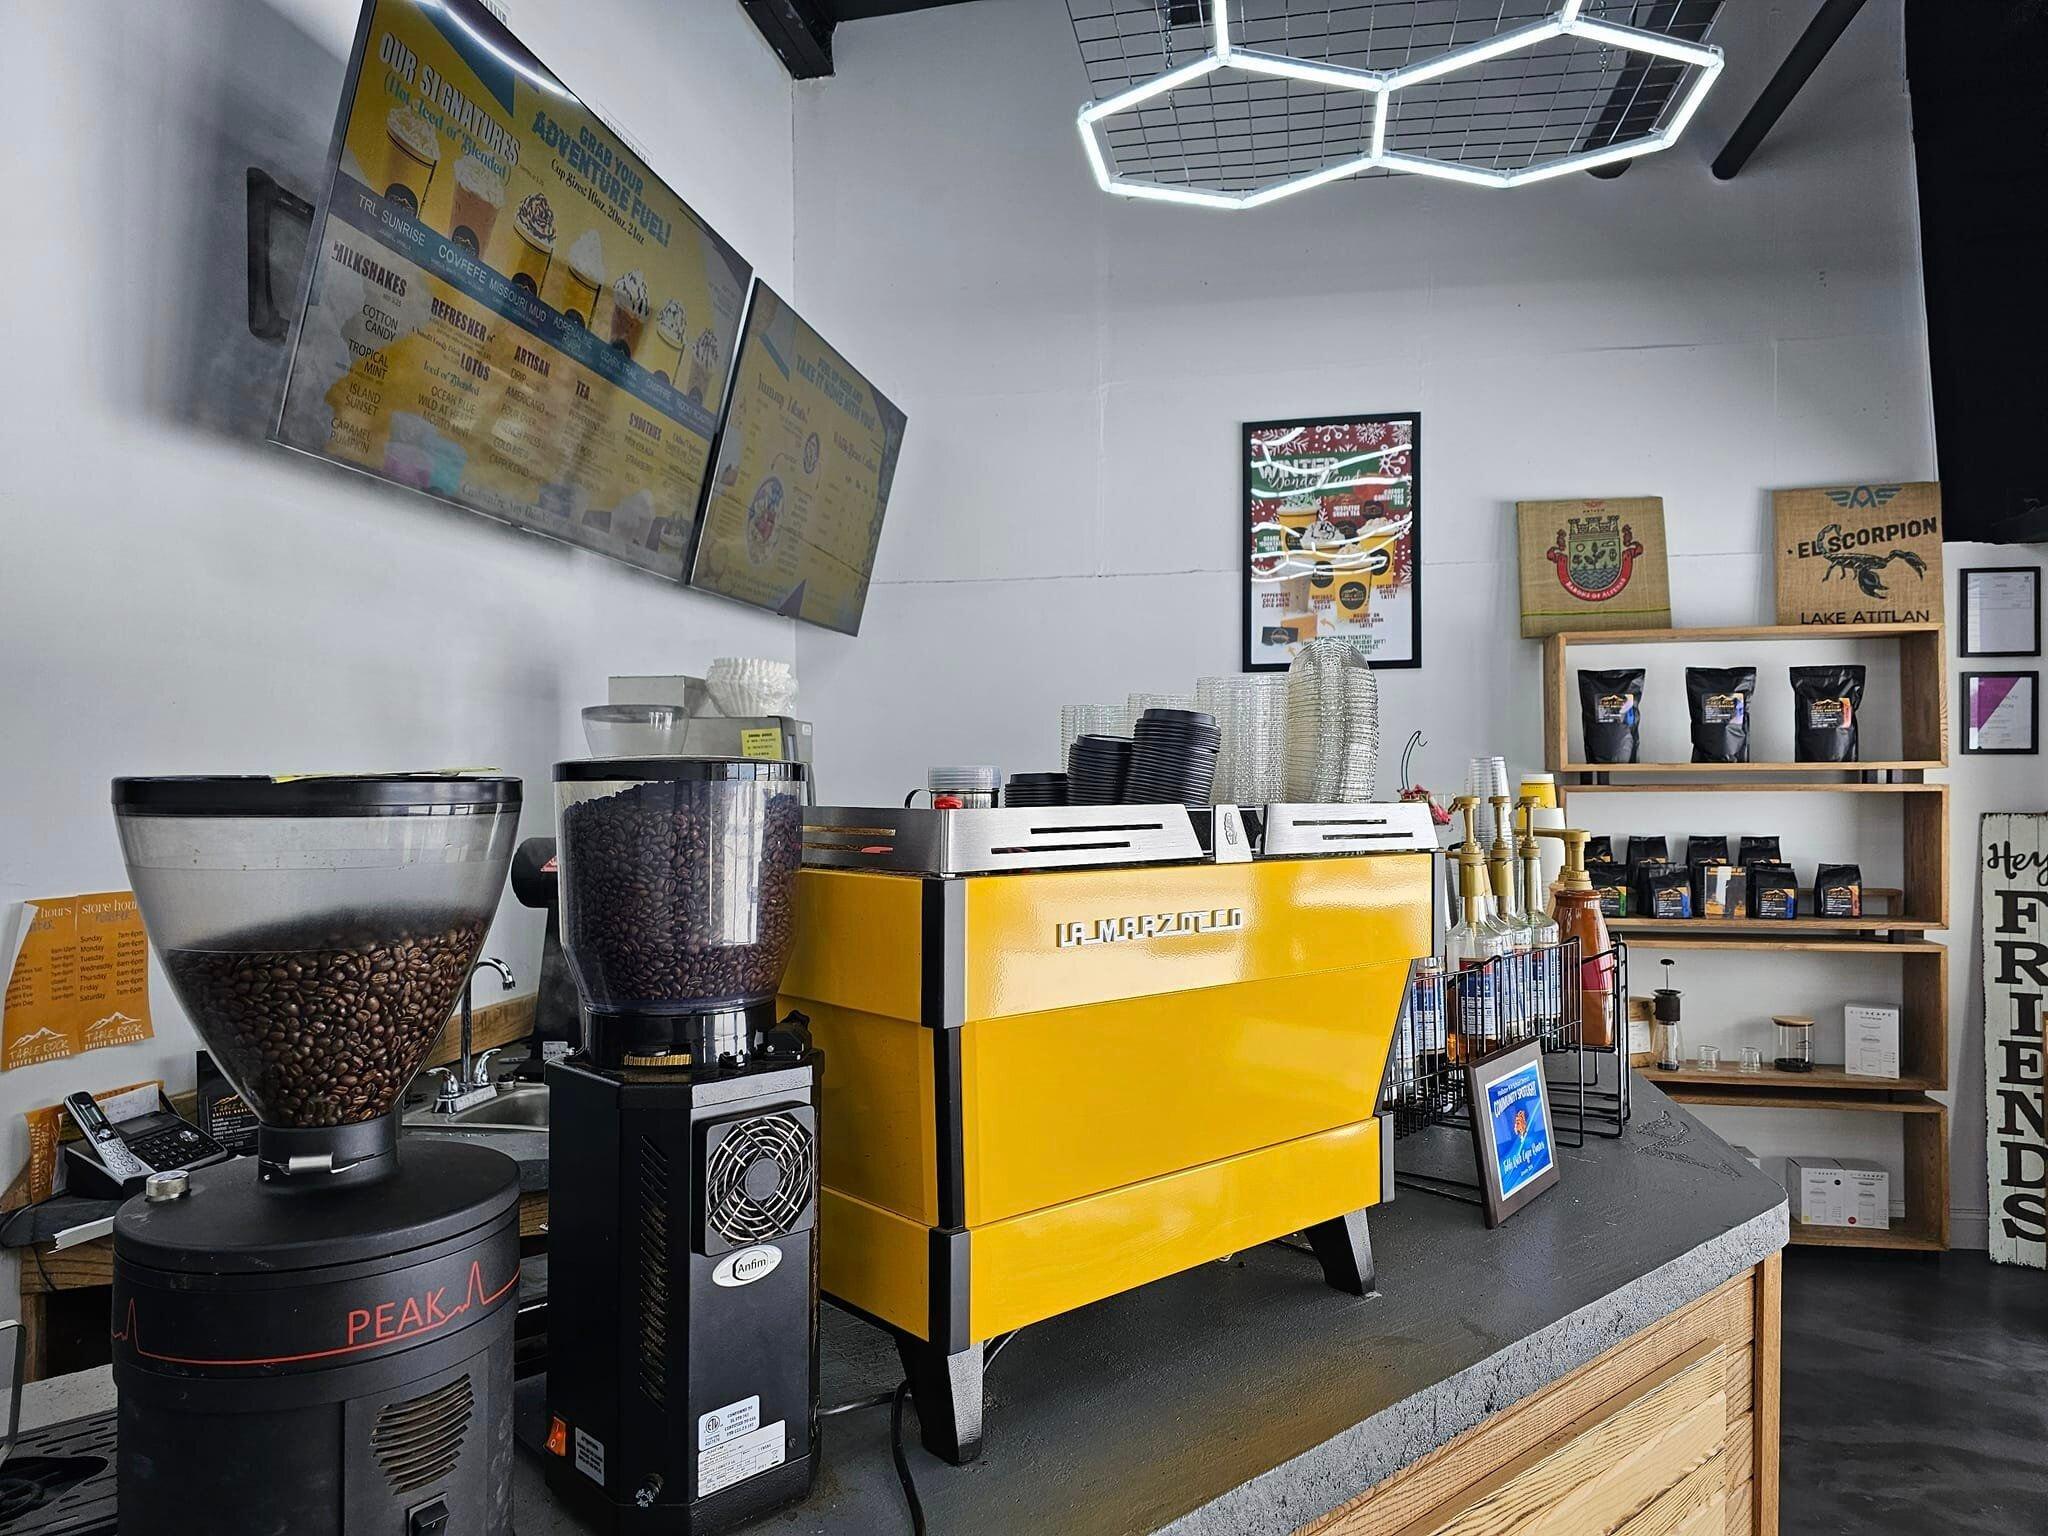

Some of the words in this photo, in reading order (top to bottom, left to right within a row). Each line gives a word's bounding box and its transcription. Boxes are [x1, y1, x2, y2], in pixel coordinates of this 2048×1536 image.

[379, 31, 418, 85] OUR
[420, 64, 520, 166] SIGNATURES
[552, 159, 567, 184] Cup
[579, 126, 613, 168] GRAB
[615, 156, 644, 197] YOUR
[532, 111, 632, 212] ADVENTURE
[631, 194, 673, 248] FUEL!
[360, 194, 378, 218] TRL
[381, 210, 426, 248] SUNRISE
[331, 241, 407, 297] MILKSHAKES
[439, 244, 487, 284] COVFEFE
[489, 277, 528, 311] MISSOURI
[529, 303, 547, 323] MUD
[362, 304, 398, 331] COTTON
[431, 297, 487, 343] REFRESHER
[365, 320, 396, 342] CANDY
[349, 339, 389, 369] TROPICAL
[514, 345, 551, 378] ARTISAN
[364, 361, 388, 381] MINT
[460, 353, 490, 381] LOTUS
[350, 383, 381, 404] ISLAND
[431, 385, 457, 405] OCEAN
[575, 380, 591, 401] TEA
[345, 396, 378, 417] SUNSET
[418, 393, 438, 411] WILD
[331, 418, 372, 441] CARAMEL
[1258, 458, 1340, 479] WINTER
[1797, 541, 1823, 559] EL
[1827, 516, 1938, 554] SCORPION
[1801, 611, 1846, 625] LAKE
[1853, 609, 1929, 624] ATITLAN
[40, 906, 73, 919] hours
[82, 902, 112, 915] store
[80, 936, 103, 944] Sunday
[1056, 922, 1087, 948] LA
[80, 955, 105, 963] Tuesday
[80, 963, 113, 972] Wednesday
[80, 974, 107, 982] Thursday
[80, 984, 99, 992] Friday
[80, 993, 106, 1002] Saturday
[85, 1028, 114, 1042] TABLE
[116, 1023, 143, 1037] ROCK
[9, 1044, 42, 1061] TABLE
[43, 1039, 69, 1055] ROCK
[1993, 889, 2048, 1243] FRIENDS
[737, 1257, 767, 1275] Anfim
[347, 1286, 447, 1346] PEAK
